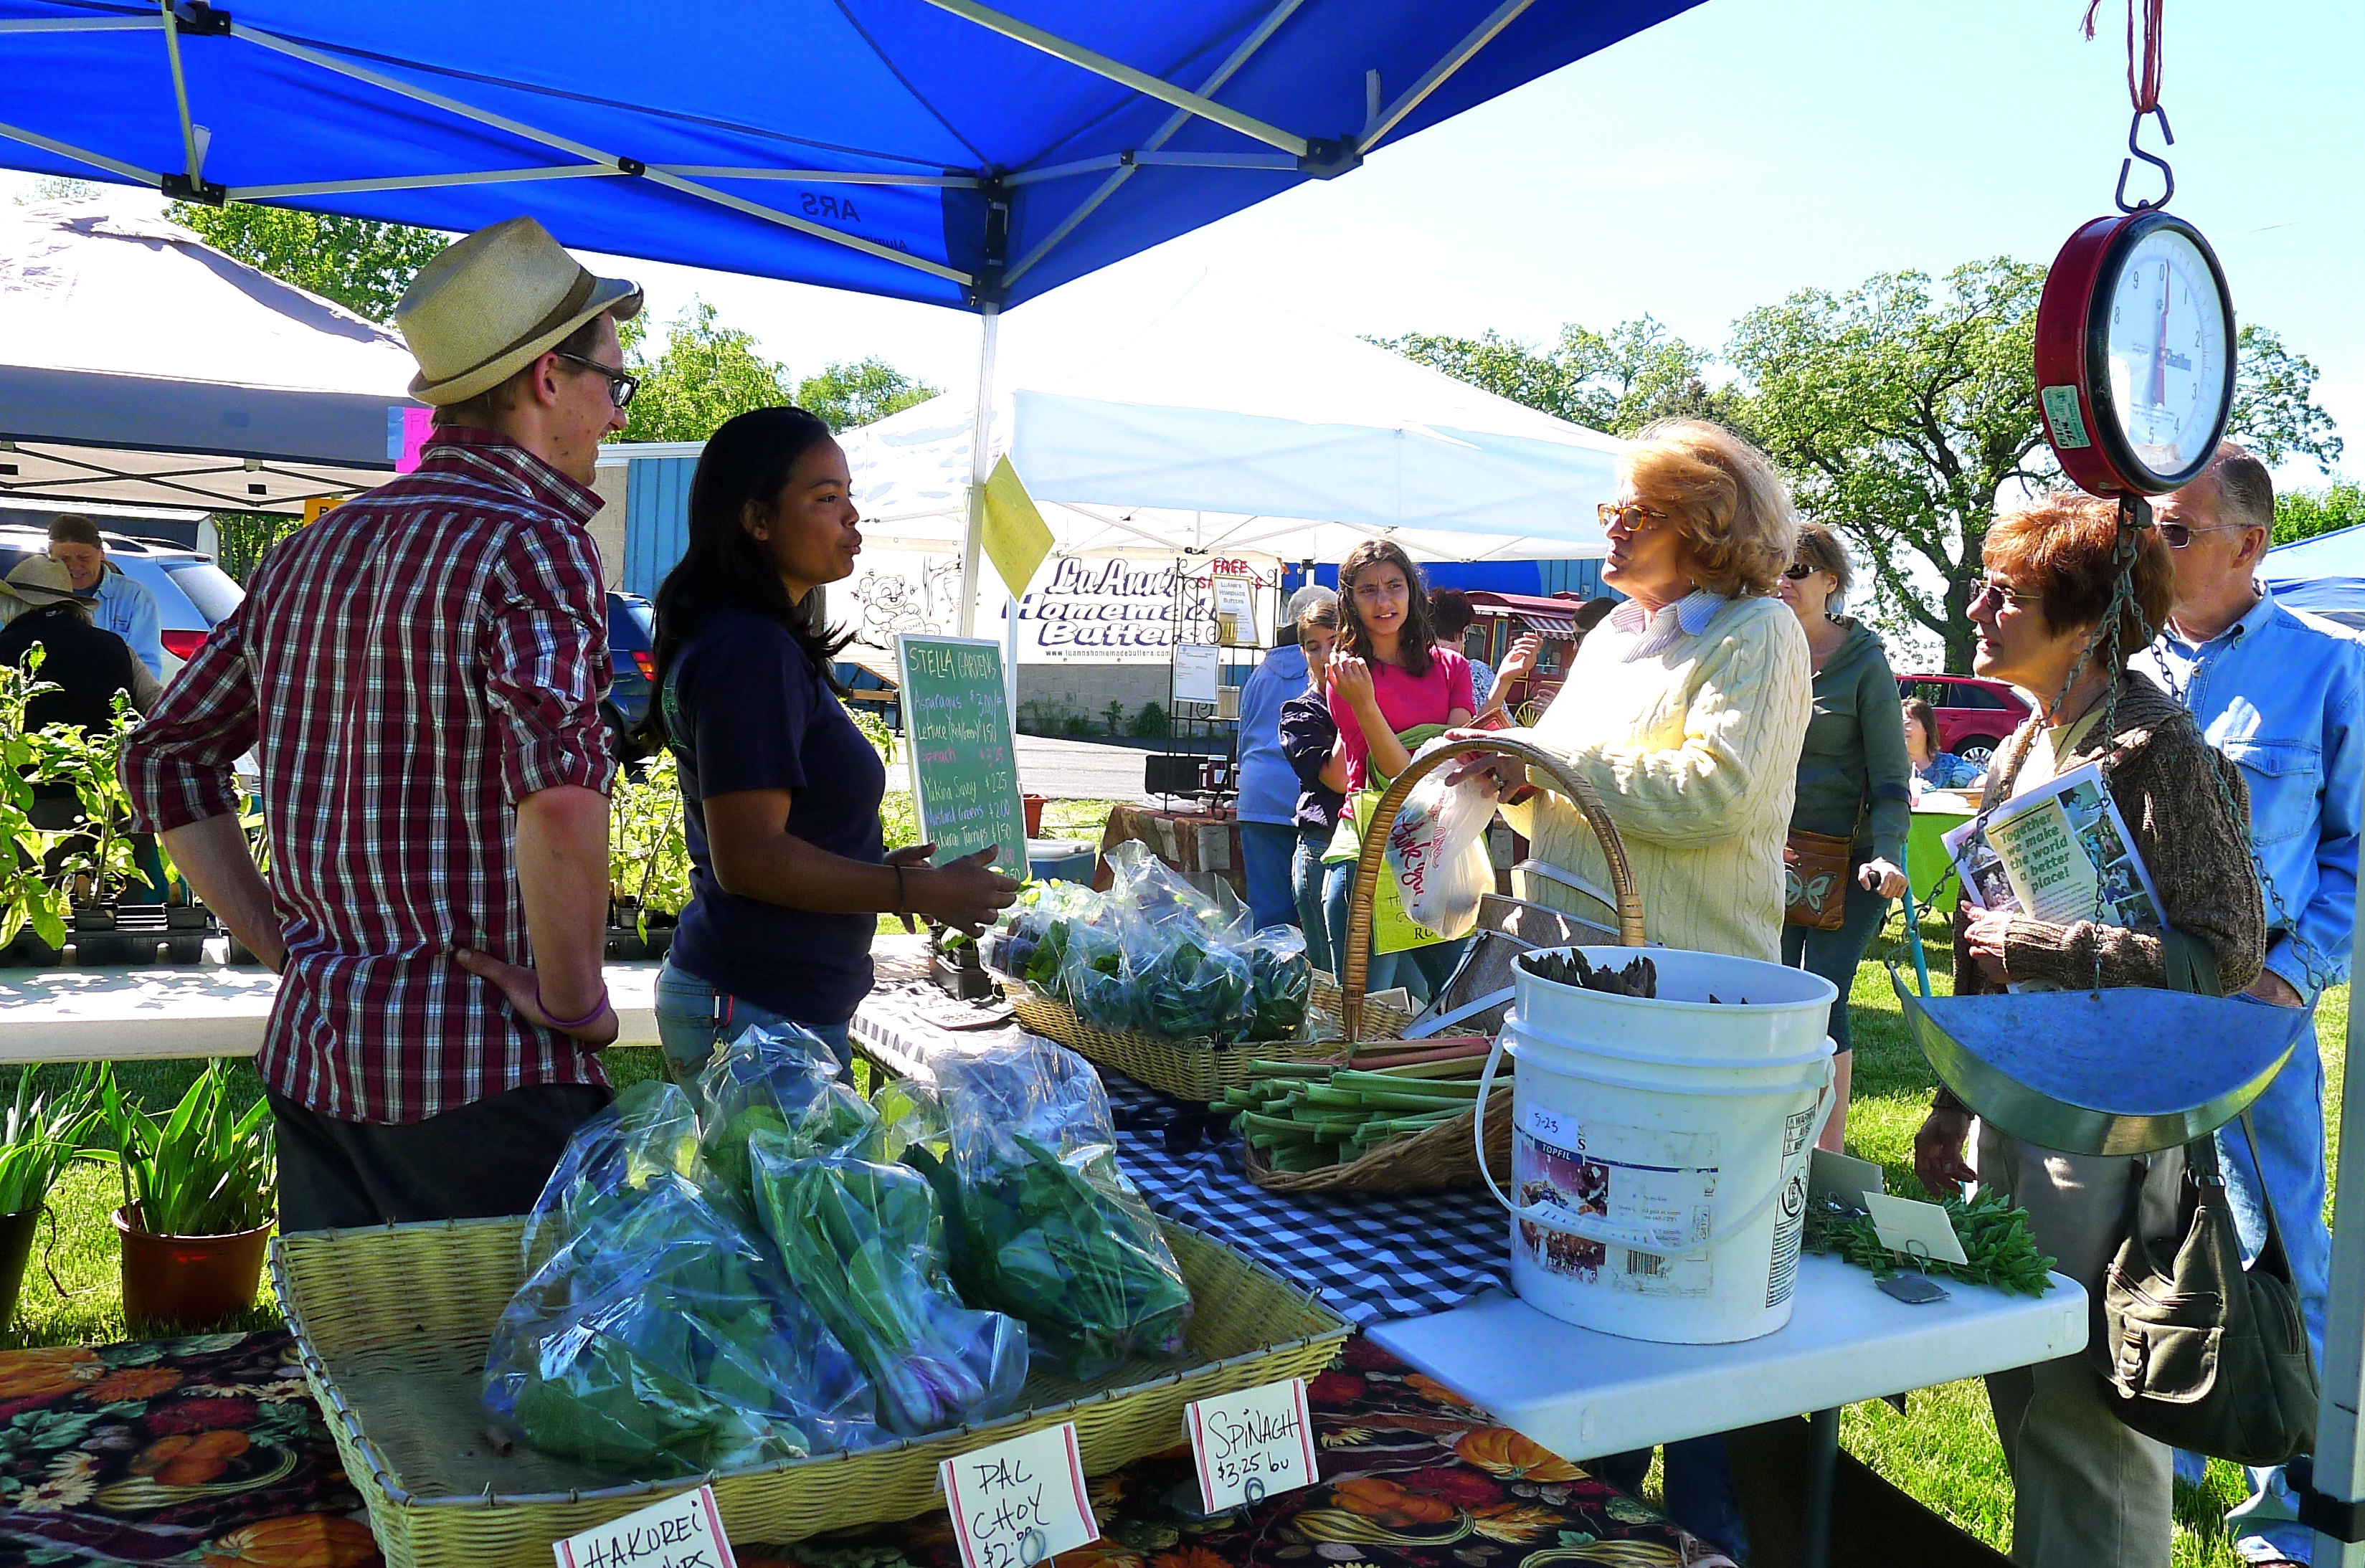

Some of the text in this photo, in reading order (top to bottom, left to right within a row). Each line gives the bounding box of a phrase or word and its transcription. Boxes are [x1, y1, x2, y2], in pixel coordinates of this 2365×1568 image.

[2133, 271, 2140, 290] 9
[2158, 264, 2166, 282] 0
[2114, 306, 2121, 325] 8
[2194, 331, 2201, 348] 2
[2191, 383, 2198, 400] 3
[2148, 426, 2155, 445] 5
[2174, 417, 2181, 434] 4
[1213, 559, 1248, 574] FREE
[1001, 593, 1217, 621] Homemad
[909, 647, 997, 680] STELLA GARDENS
[913, 687, 962, 721] Asparagus
[921, 747, 956, 771] Spinach
[2000, 812, 2052, 844] Together
[2006, 826, 2060, 857] we make
[2009, 834, 2068, 871] the world
[2019, 852, 2070, 882] a better
[2031, 866, 2070, 895] place!
[1534, 1113, 1558, 1134] 5-23
[1542, 1143, 1571, 1161] TOPFIL
[1218, 1451, 1289, 1488] $3.25 bu
[972, 1483, 1050, 1539] CHOY
